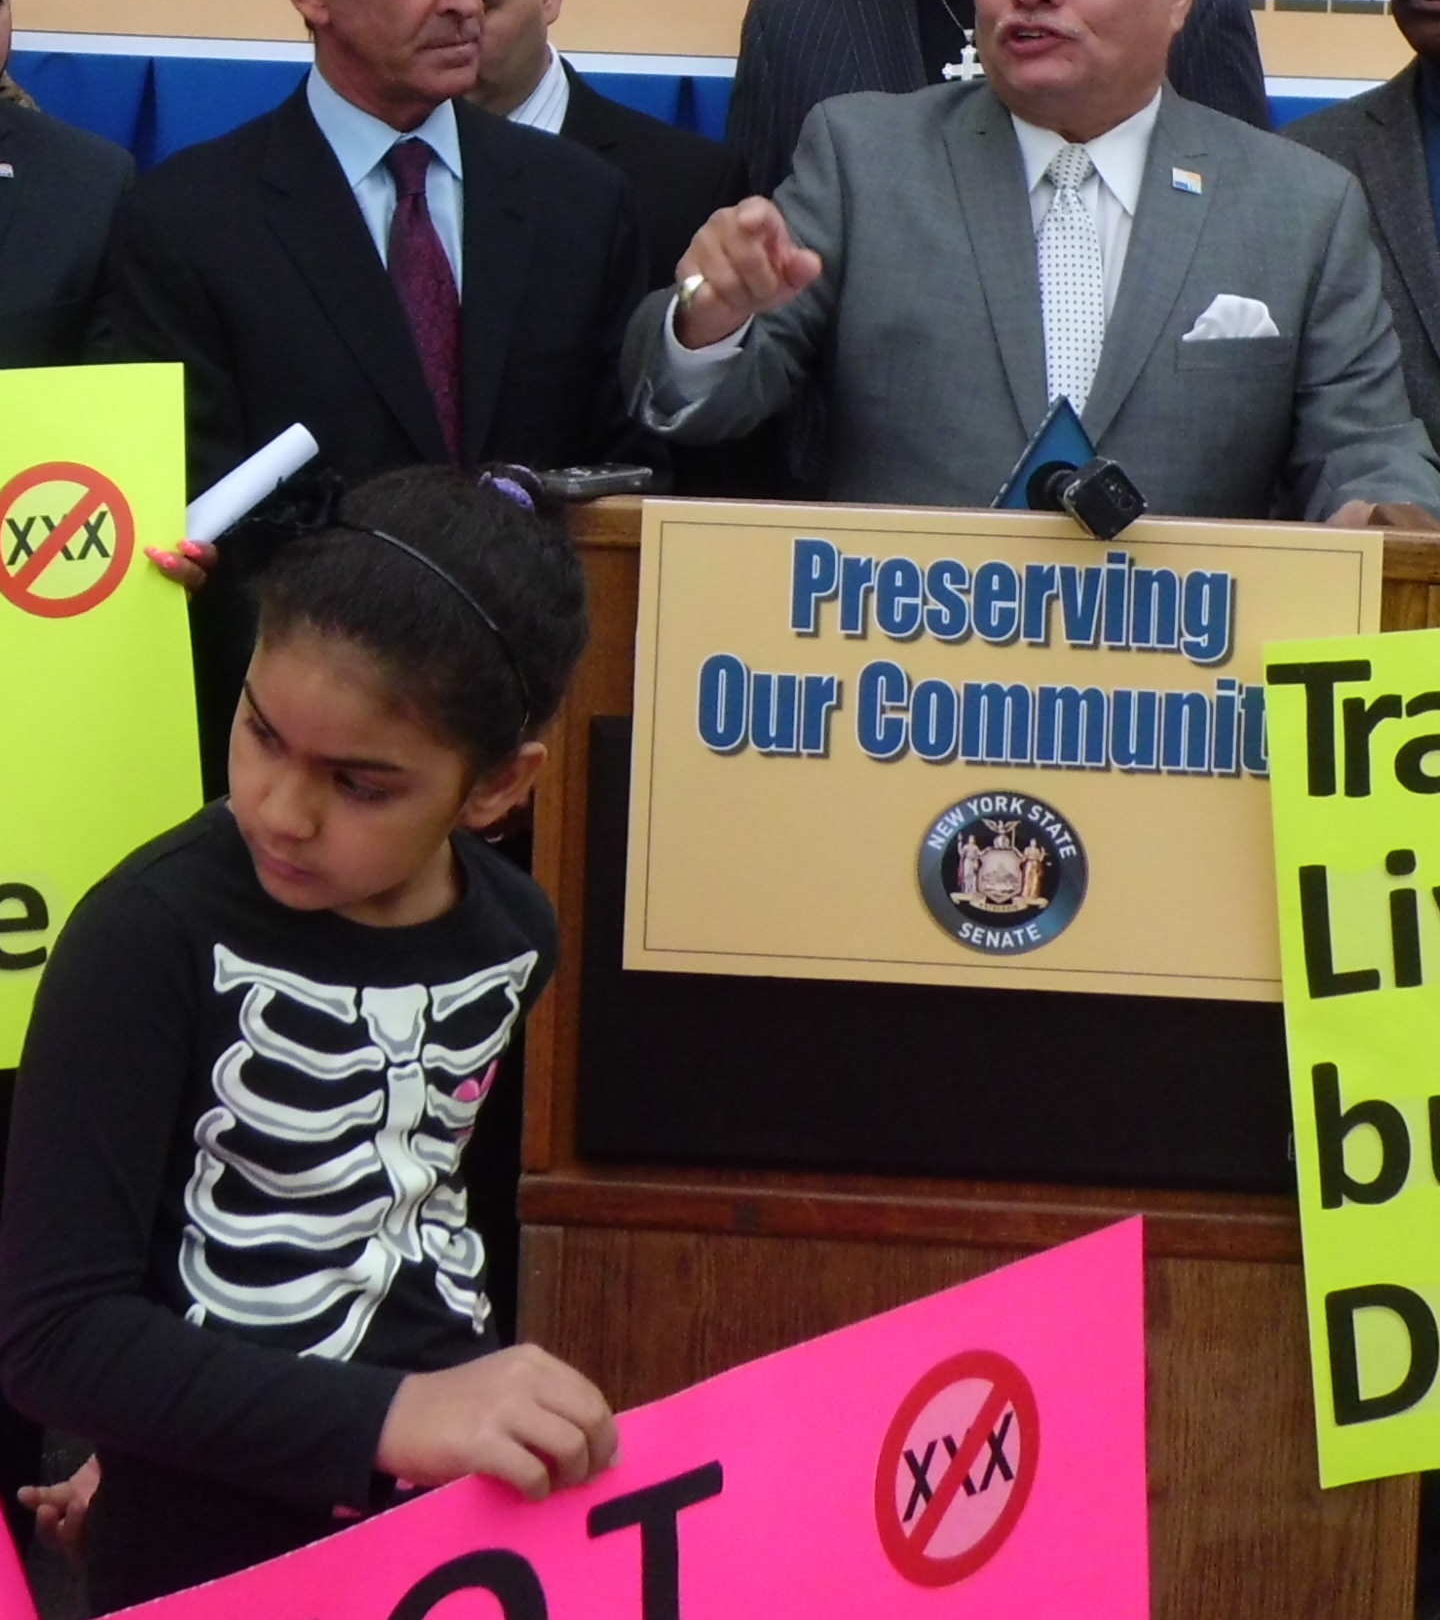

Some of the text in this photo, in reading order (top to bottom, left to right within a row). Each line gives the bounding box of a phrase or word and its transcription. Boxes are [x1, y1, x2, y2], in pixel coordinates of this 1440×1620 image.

[790, 536, 1234, 665] Preserving
[695, 652, 1270, 774] Our Communit
[927, 795, 1078, 860] NEW YORK STATE
[957, 922, 1043, 949] SENATE
